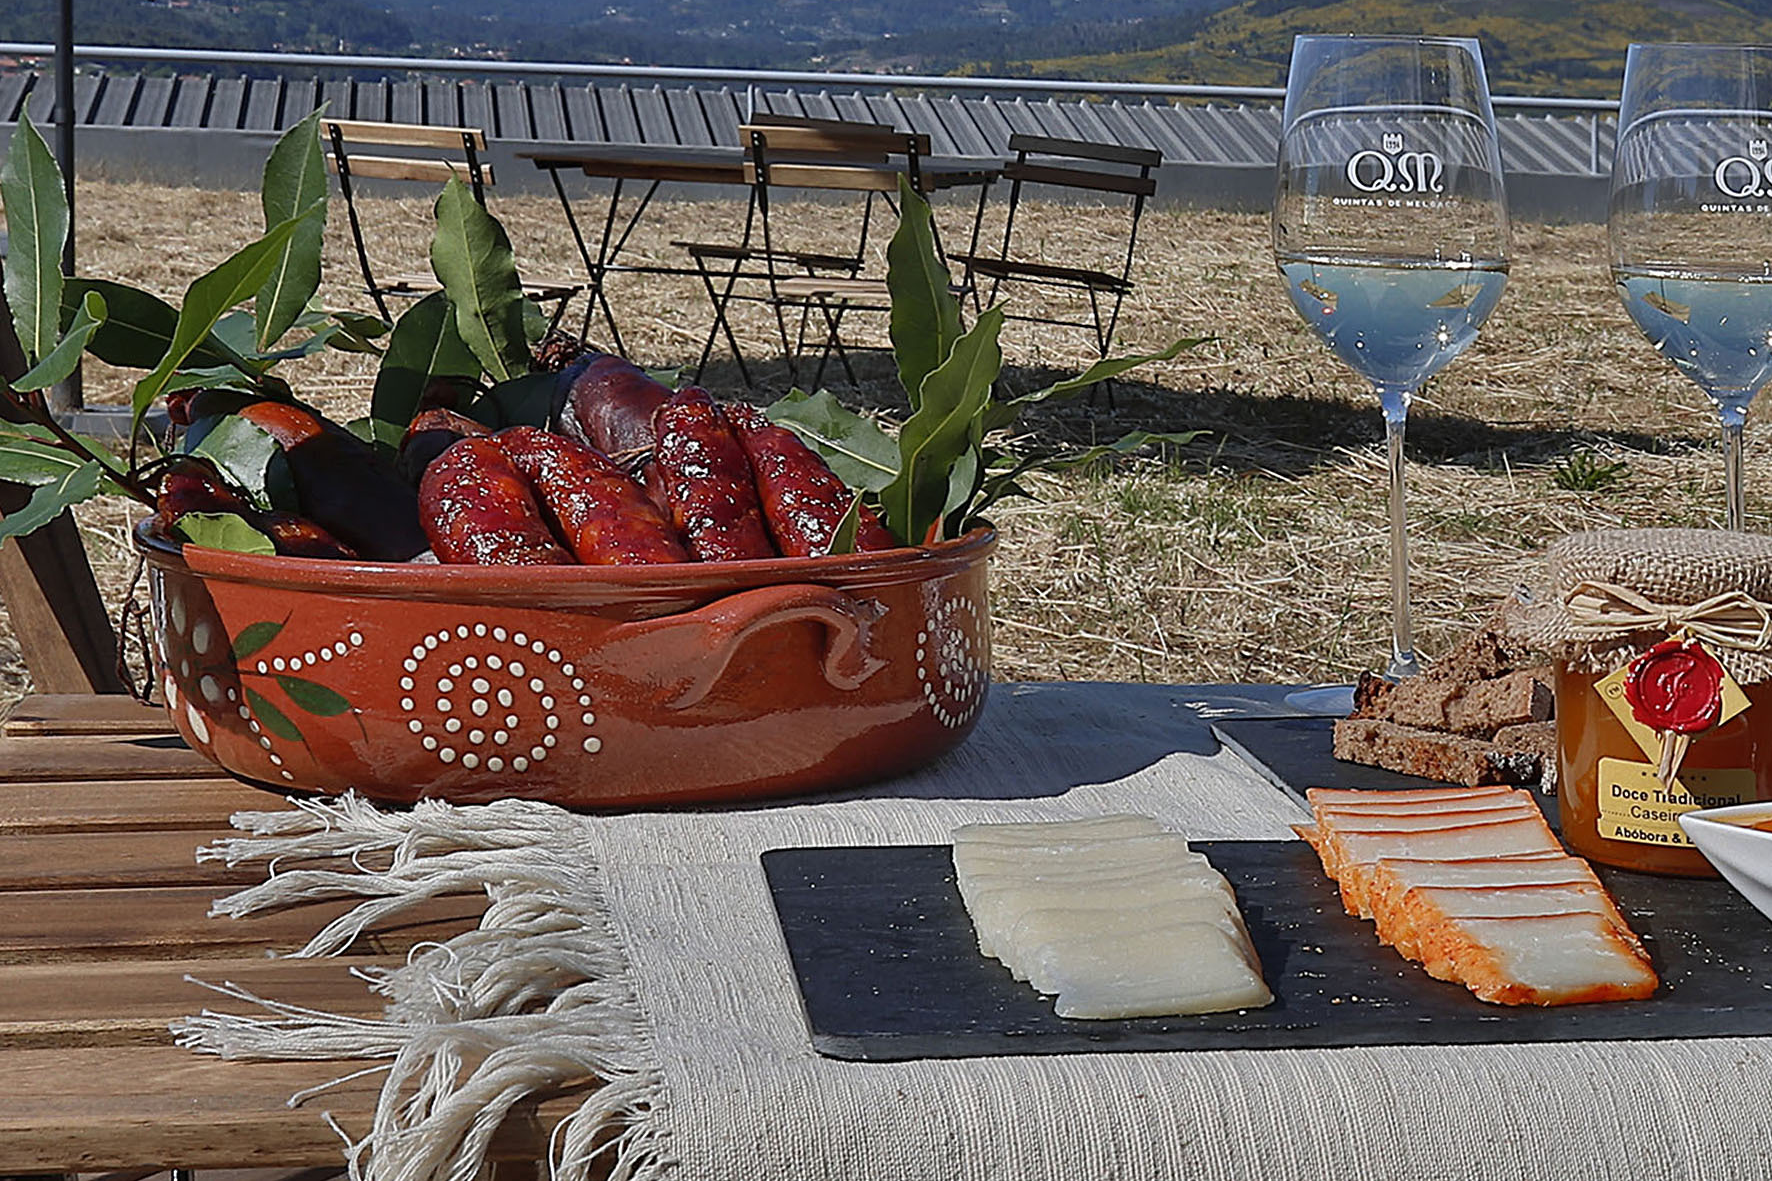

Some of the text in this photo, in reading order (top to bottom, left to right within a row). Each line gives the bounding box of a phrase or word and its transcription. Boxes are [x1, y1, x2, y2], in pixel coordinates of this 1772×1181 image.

[1347, 150, 1444, 193] QM
[1333, 197, 1383, 207] QUINTAS
[1388, 199, 1401, 208] DE
[1701, 204, 1751, 213] QUINTAS
[1757, 205, 1768, 213] DE
[1611, 784, 1741, 806] Doce Tradicional
[1630, 805, 1684, 822] Caseir
[1615, 826, 1668, 843] Abóbora
[1671, 833, 1682, 844] &
